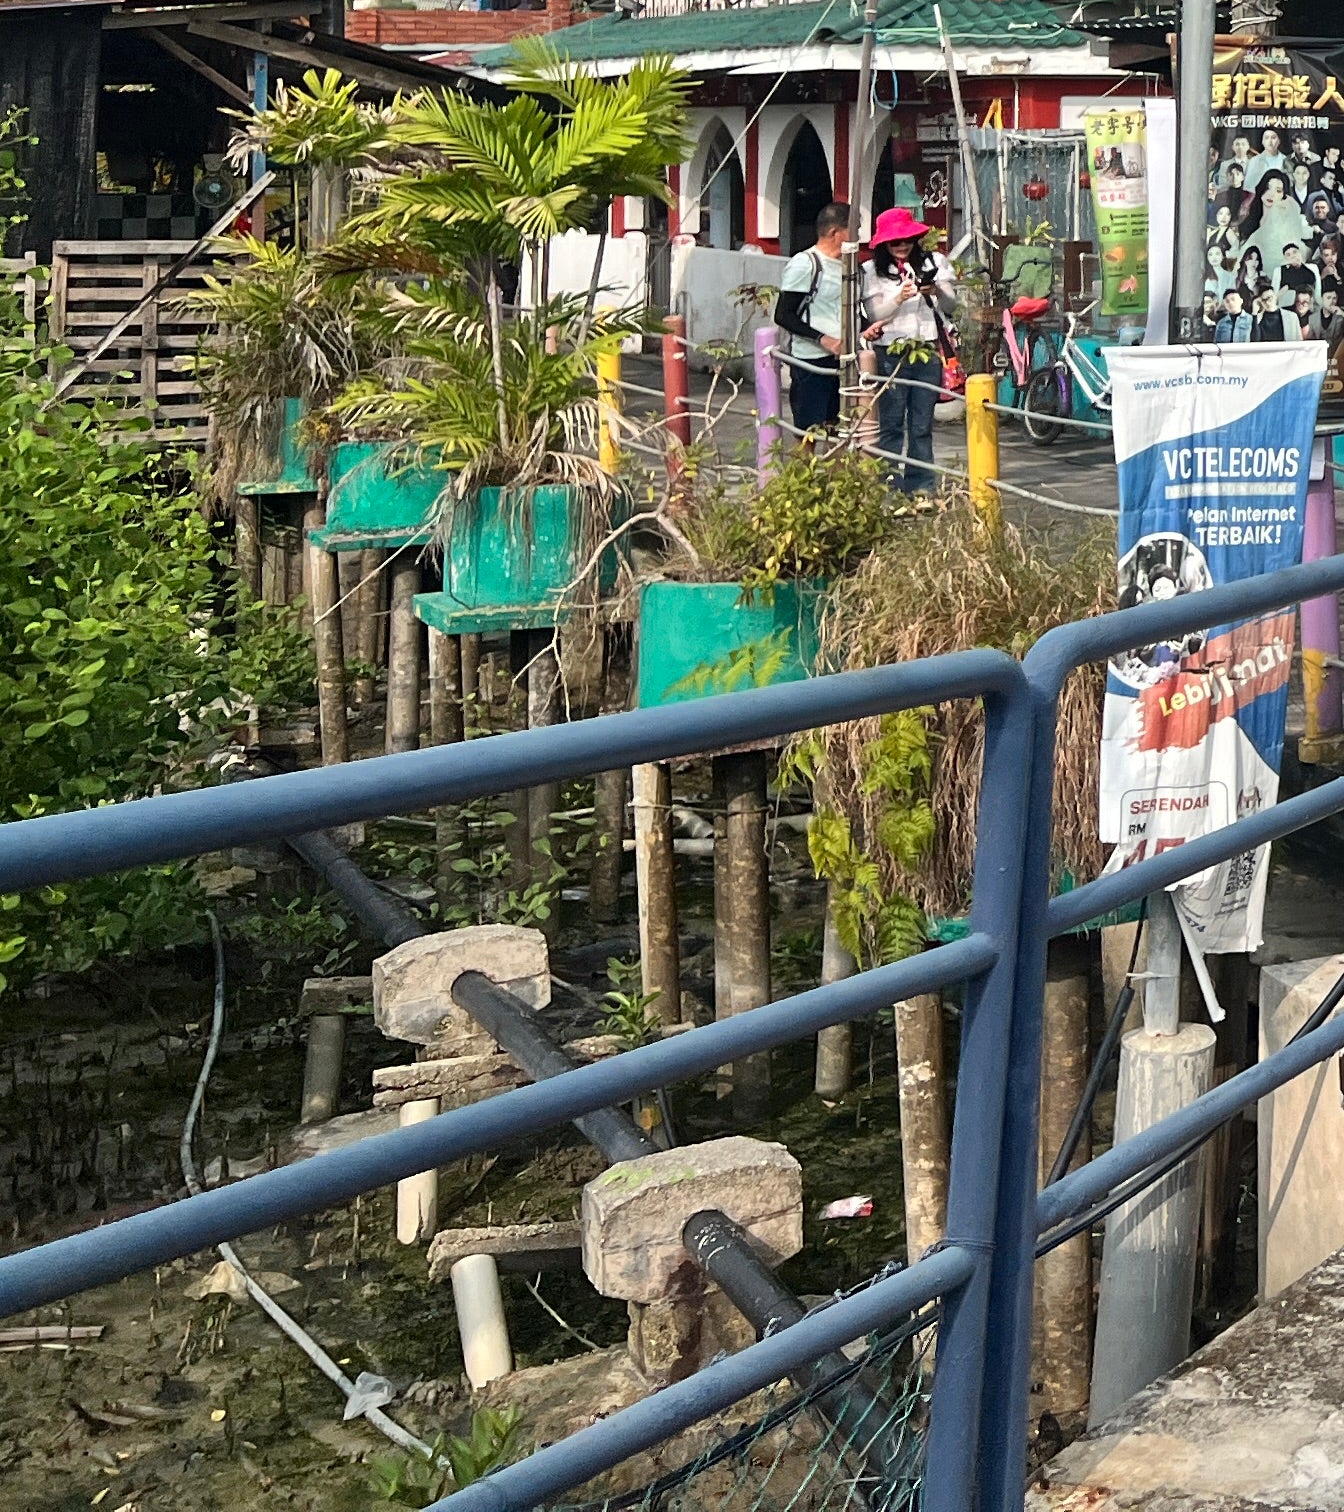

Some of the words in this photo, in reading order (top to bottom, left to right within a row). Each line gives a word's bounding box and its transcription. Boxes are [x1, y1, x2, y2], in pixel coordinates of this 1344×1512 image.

[1133, 374, 1249, 390] www.vcsb.com.my
[1231, 505, 1297, 523] Internet
[1195, 524, 1282, 547] TERBAIK!
[1128, 822, 1147, 836] RM
